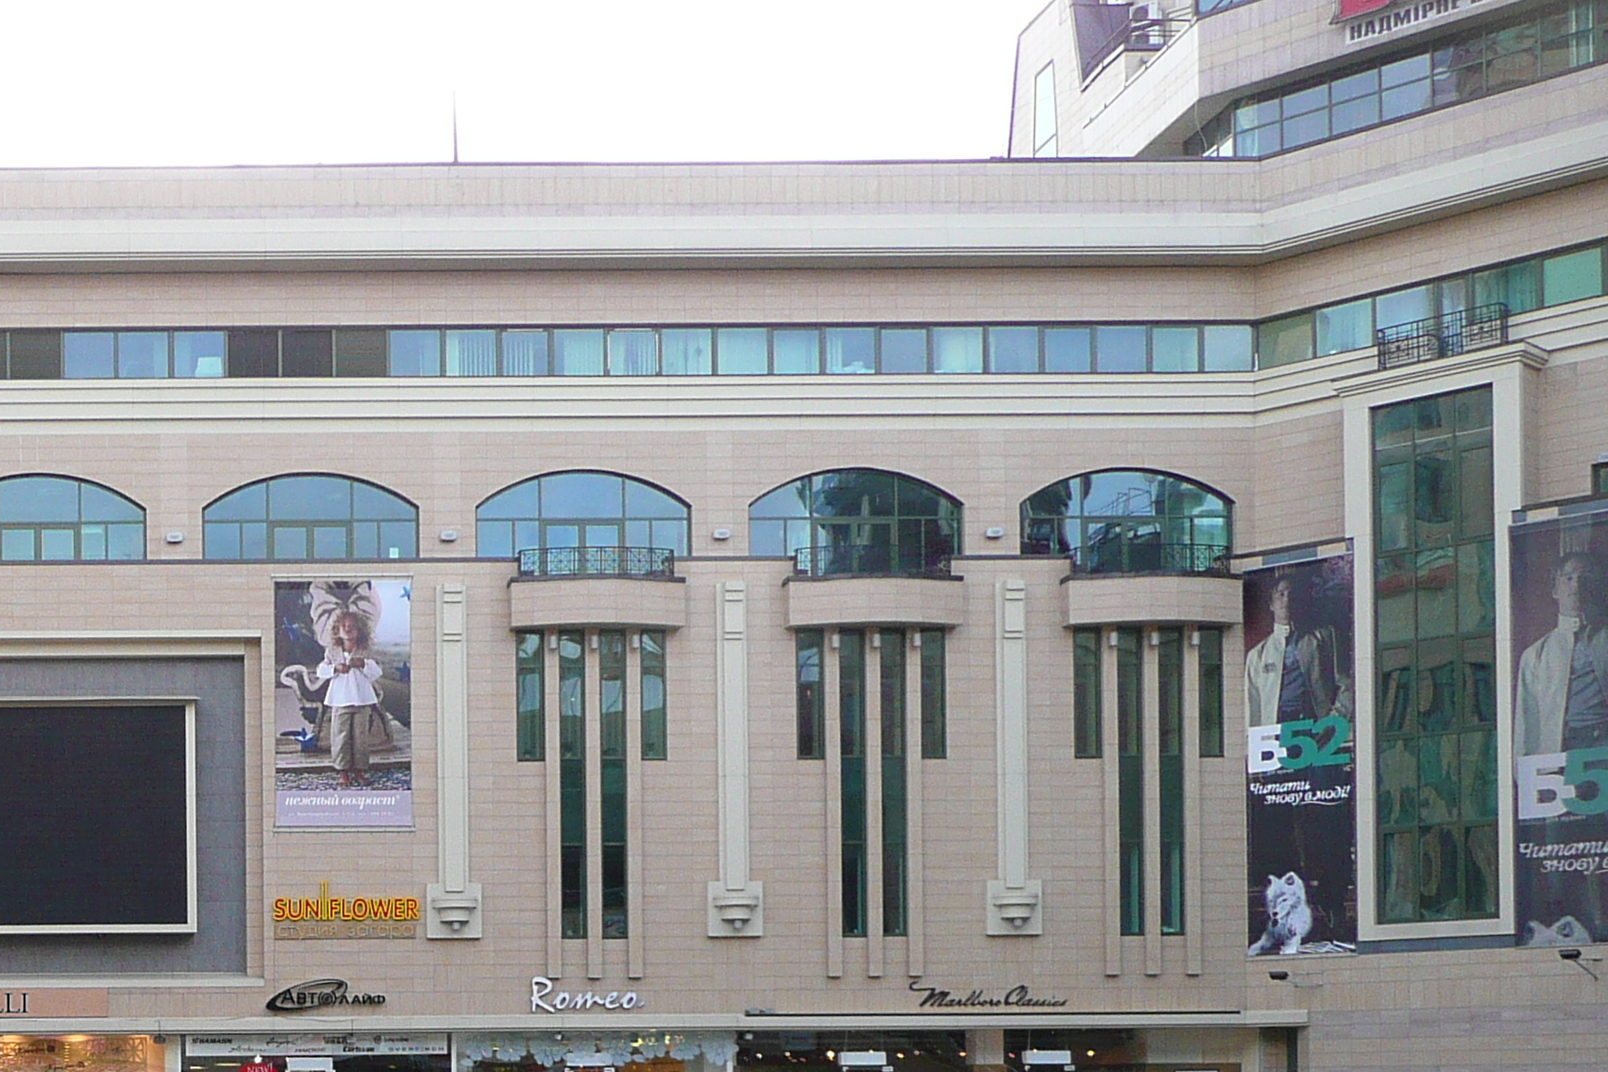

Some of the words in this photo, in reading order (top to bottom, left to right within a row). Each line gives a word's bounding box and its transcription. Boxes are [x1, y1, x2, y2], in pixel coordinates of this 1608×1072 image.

[1250, 781, 1311, 794] Читати
[285, 794, 340, 806] нежный
[909, 981, 1003, 1007] Marlboro
[1004, 985, 1068, 1007] Classics
